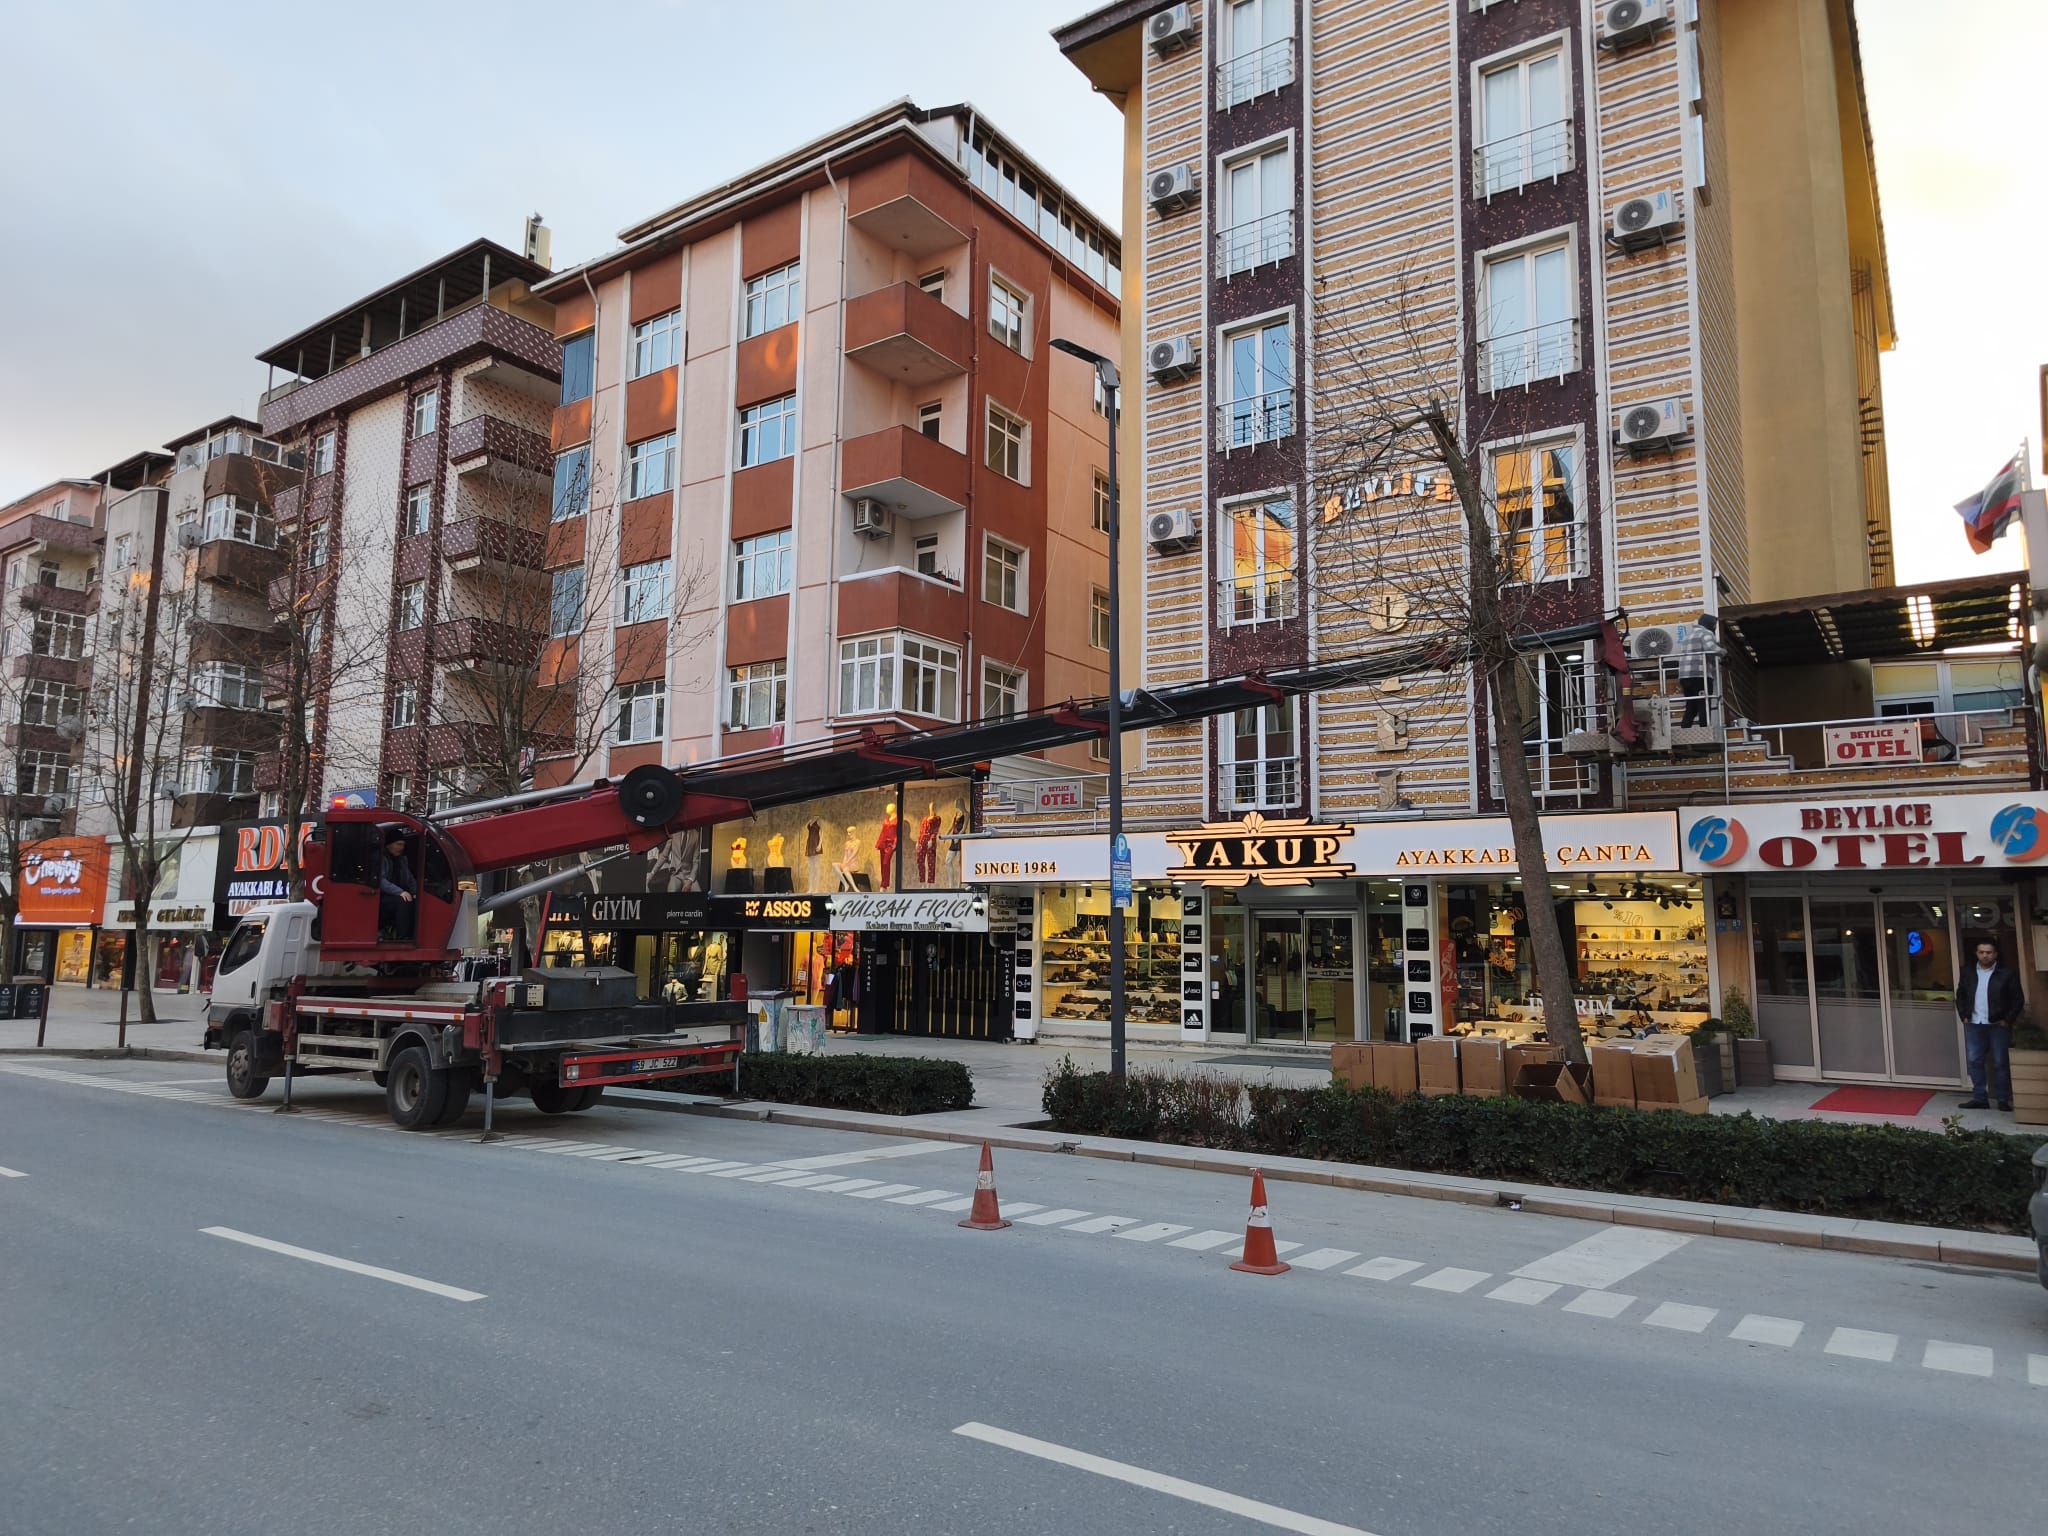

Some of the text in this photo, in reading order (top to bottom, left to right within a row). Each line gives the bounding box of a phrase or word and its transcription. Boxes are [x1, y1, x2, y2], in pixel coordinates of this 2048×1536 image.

[1368, 590, 1411, 812] OEL
[1837, 740, 1911, 759] OTEL
[1041, 793, 1077, 806] OTEL
[1178, 837, 1338, 867] YAKUP
[1396, 848, 1519, 865] AYAKKABI
[1557, 844, 1652, 865] ÇANTA
[1759, 831, 1985, 868] OTEL
[975, 861, 1056, 875] SINCE 1984
[228, 881, 274, 897] AYAKKABI
[275, 880, 283, 895] &
[592, 896, 642, 921] GİYİM
[666, 909, 703, 919] pierre cardin
[762, 900, 812, 917] ASSOS
[839, 895, 912, 922] GÜLŞAH
[636, 1060, 645, 1070] 59
[649, 1059, 659, 1068] JC
